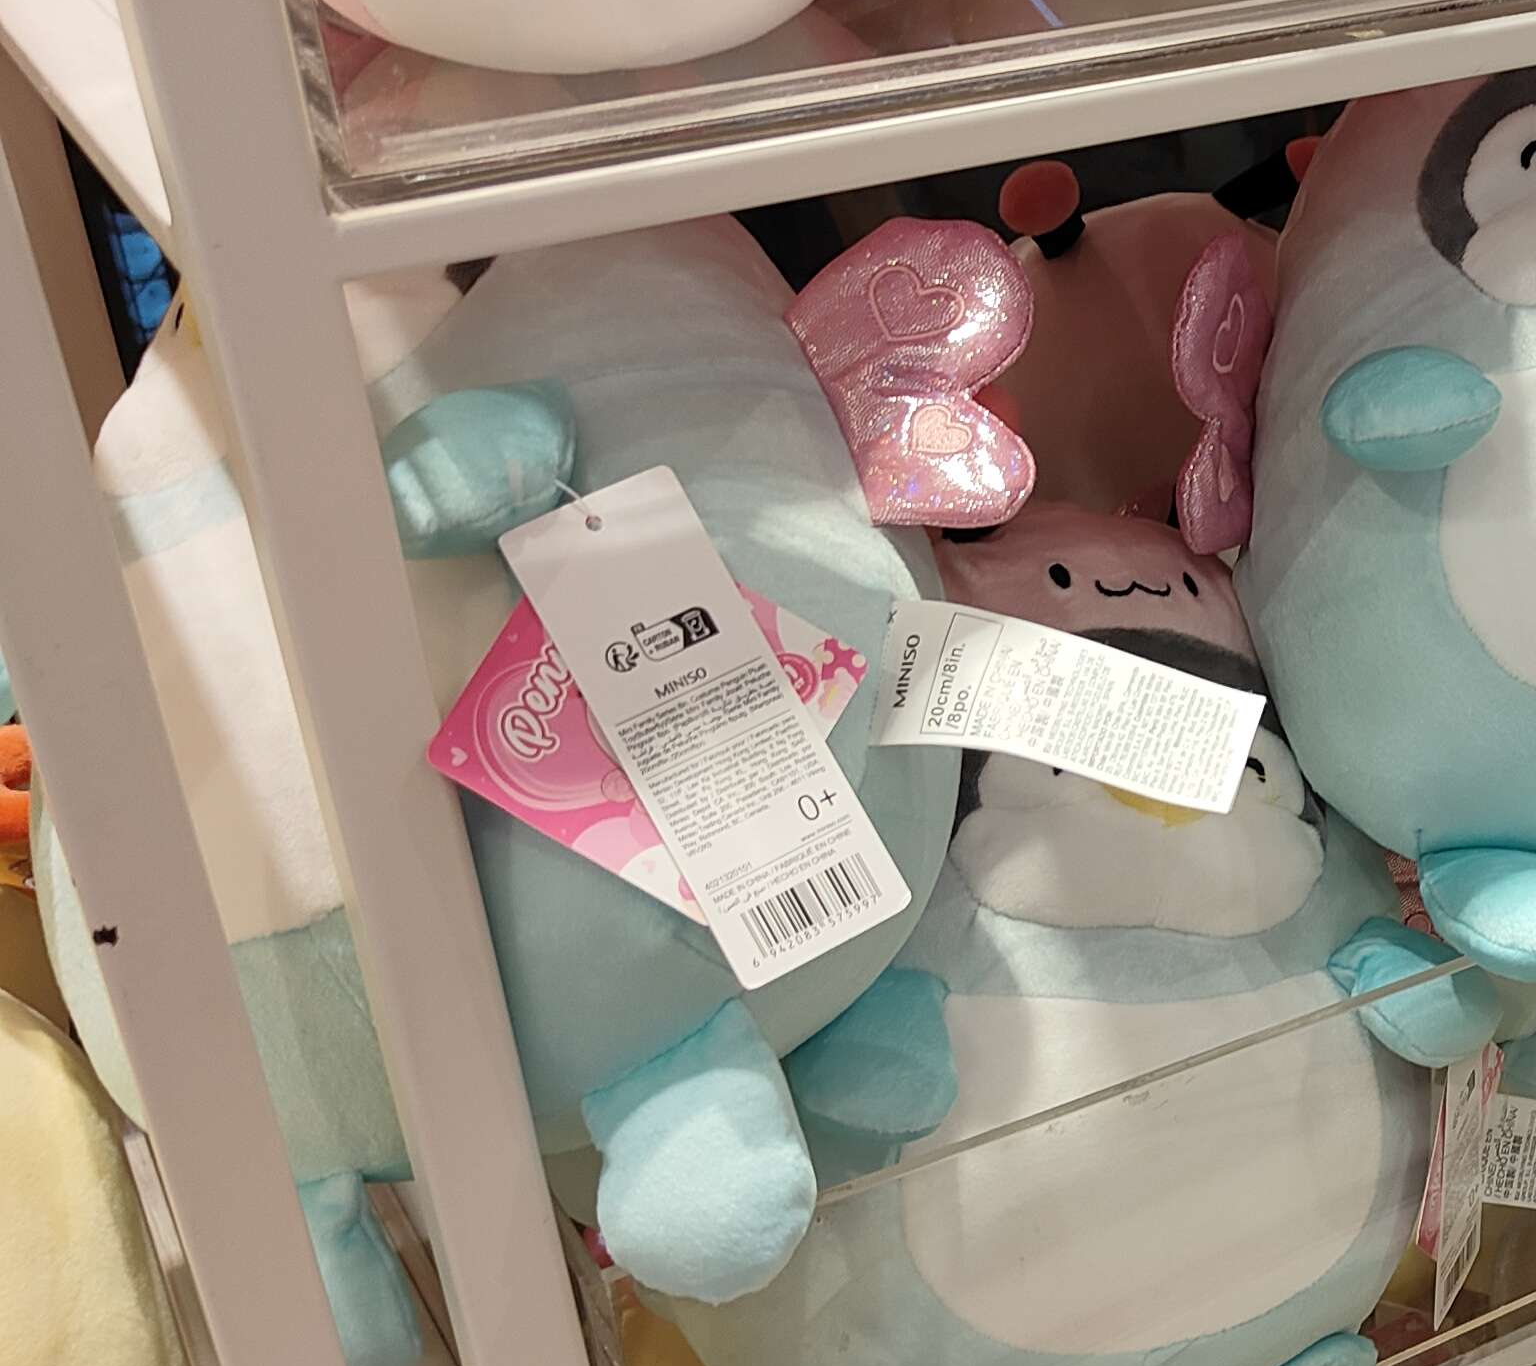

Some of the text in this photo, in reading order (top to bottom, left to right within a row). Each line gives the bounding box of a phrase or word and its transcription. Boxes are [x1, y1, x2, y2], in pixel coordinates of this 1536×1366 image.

[654, 667, 708, 699] MINISO
[893, 633, 921, 708] MINISO
[927, 641, 967, 727] 20cm/8in.
[945, 684, 973, 734] /8po.
[797, 789, 838, 822] 0+
